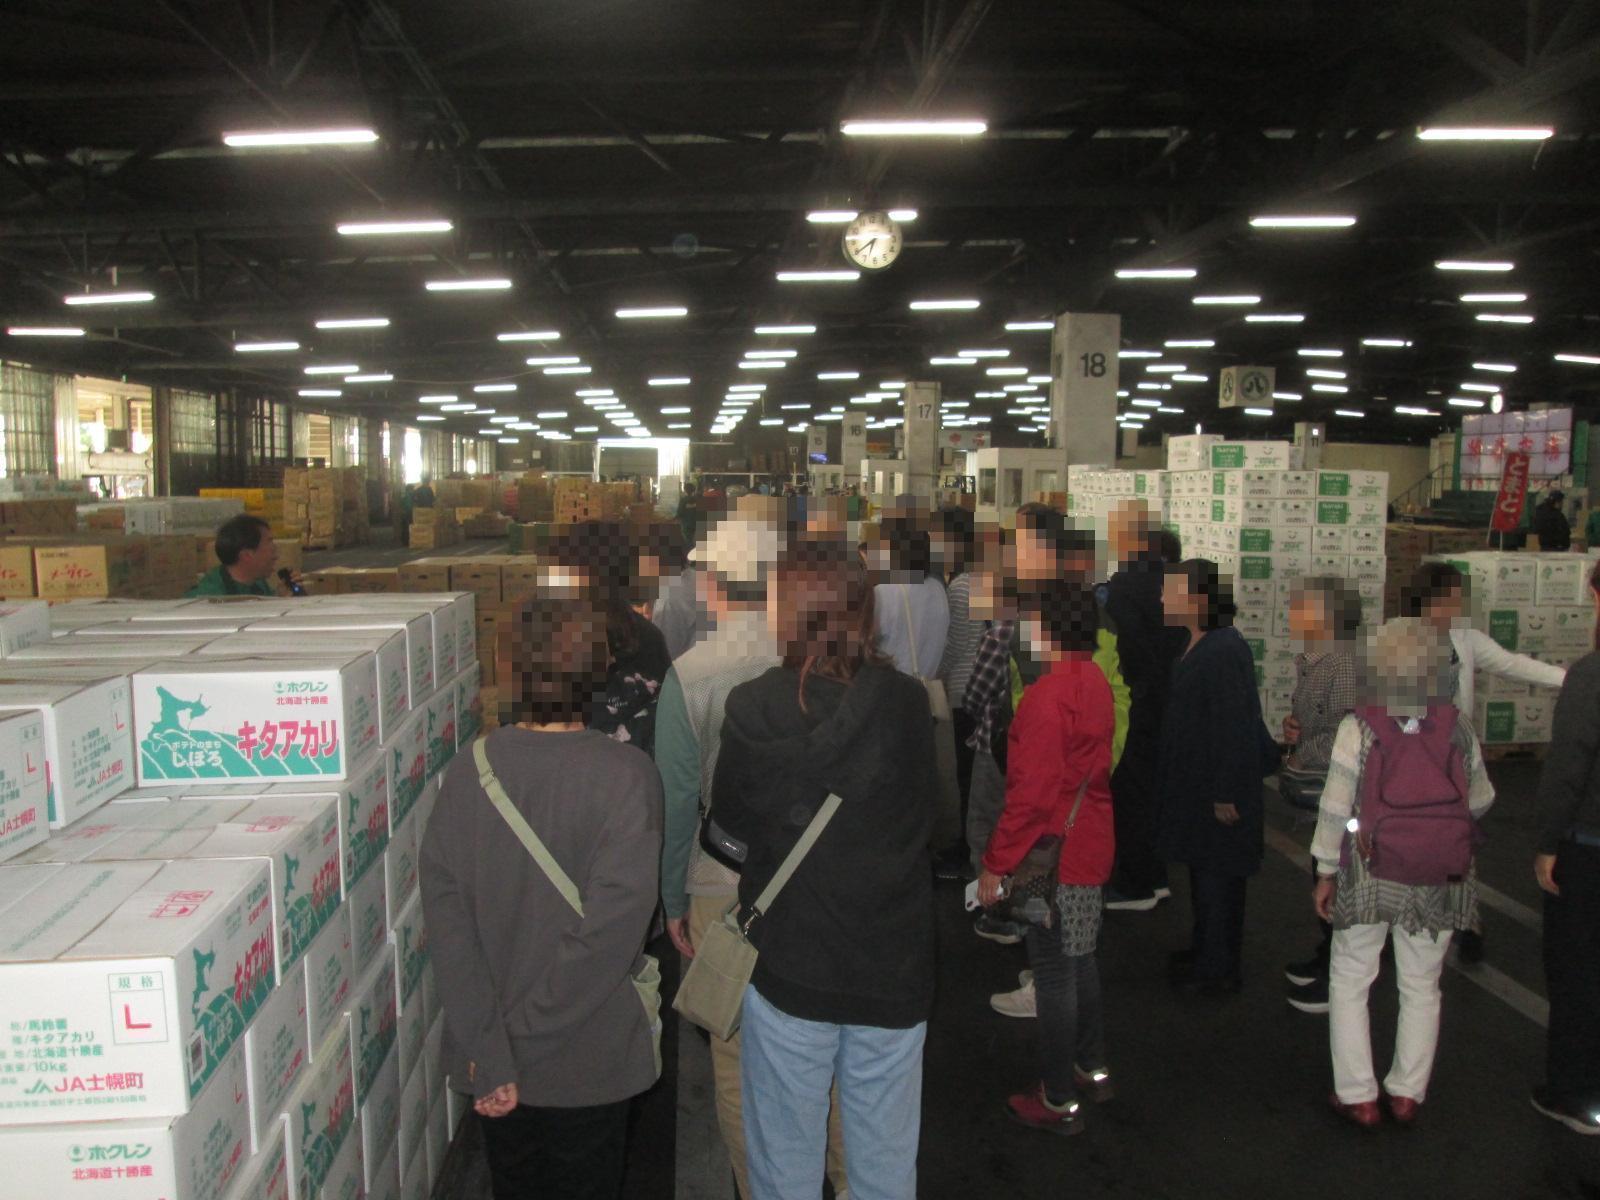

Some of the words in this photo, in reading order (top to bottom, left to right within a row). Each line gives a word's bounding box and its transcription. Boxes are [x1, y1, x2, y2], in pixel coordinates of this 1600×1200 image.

[1081, 352, 1107, 378] 18
[918, 404, 932, 419] 17
[851, 425, 862, 437] 16
[287, 681, 329, 693] ホクレン
[276, 696, 329, 706] 北海道十勝産
[115, 712, 125, 731] L
[238, 719, 337, 760] キタアカリ
[26, 752, 37, 773] L
[124, 1004, 153, 1029] L
[54, 1072, 144, 1093] JA士幌町
[88, 1143, 152, 1161] ホクレン
[72, 1165, 153, 1181] 北海道十勝産
